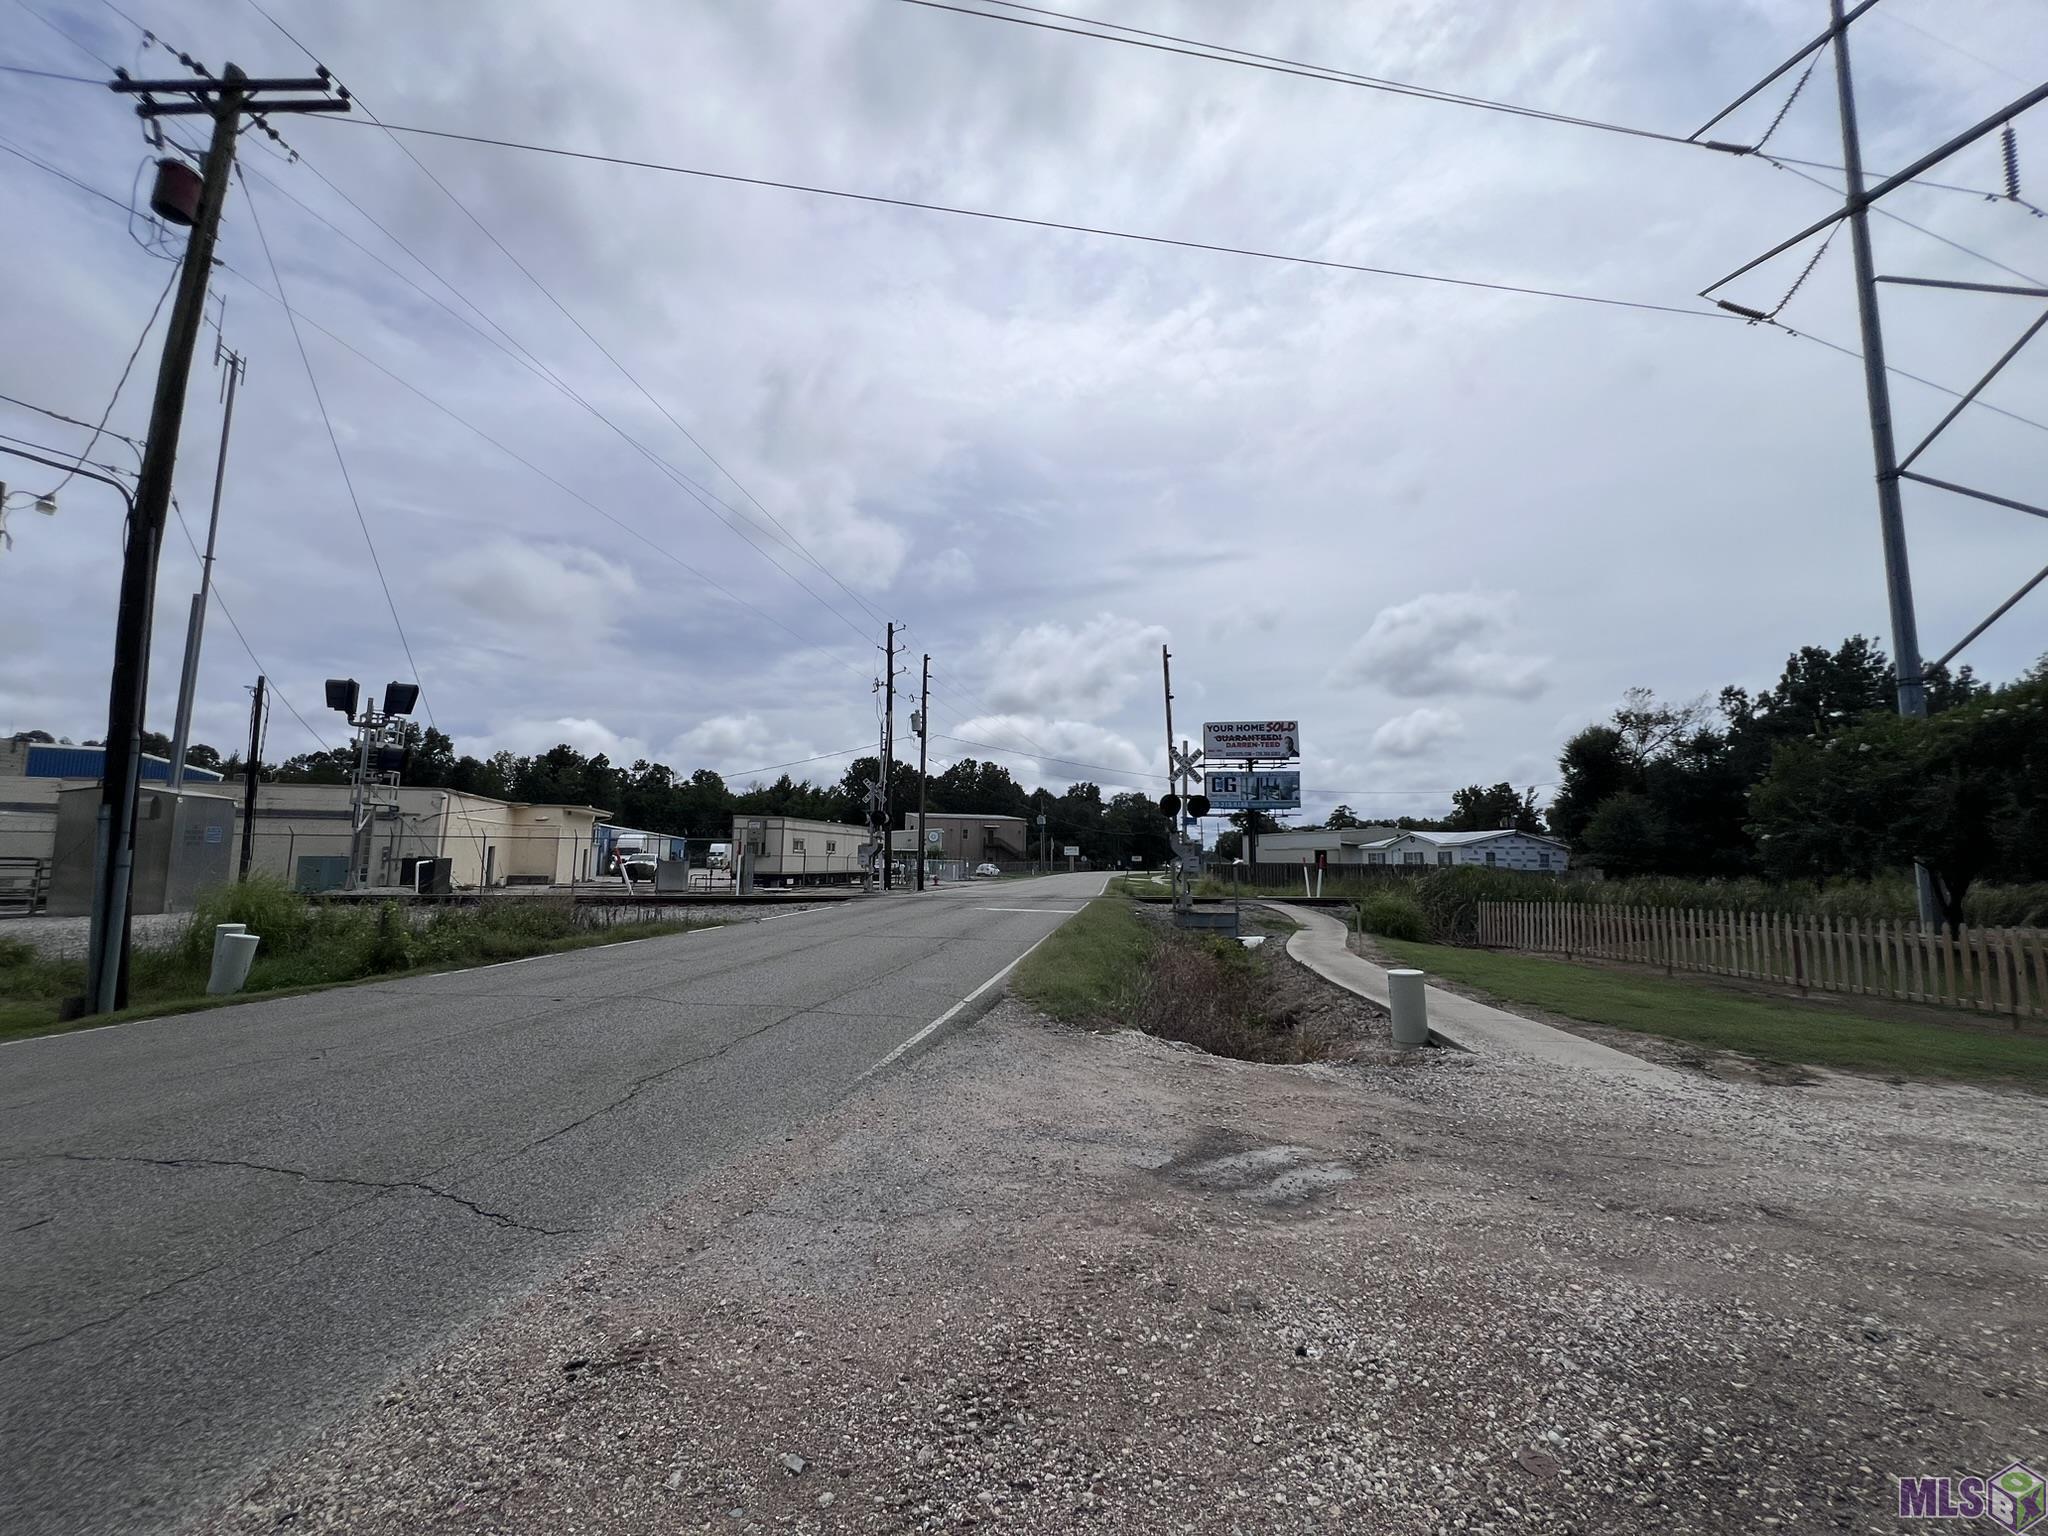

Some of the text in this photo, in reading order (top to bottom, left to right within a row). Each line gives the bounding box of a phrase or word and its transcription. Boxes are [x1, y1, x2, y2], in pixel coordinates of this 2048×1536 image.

[1206, 722, 1296, 732] YOUR HOME SOLD
